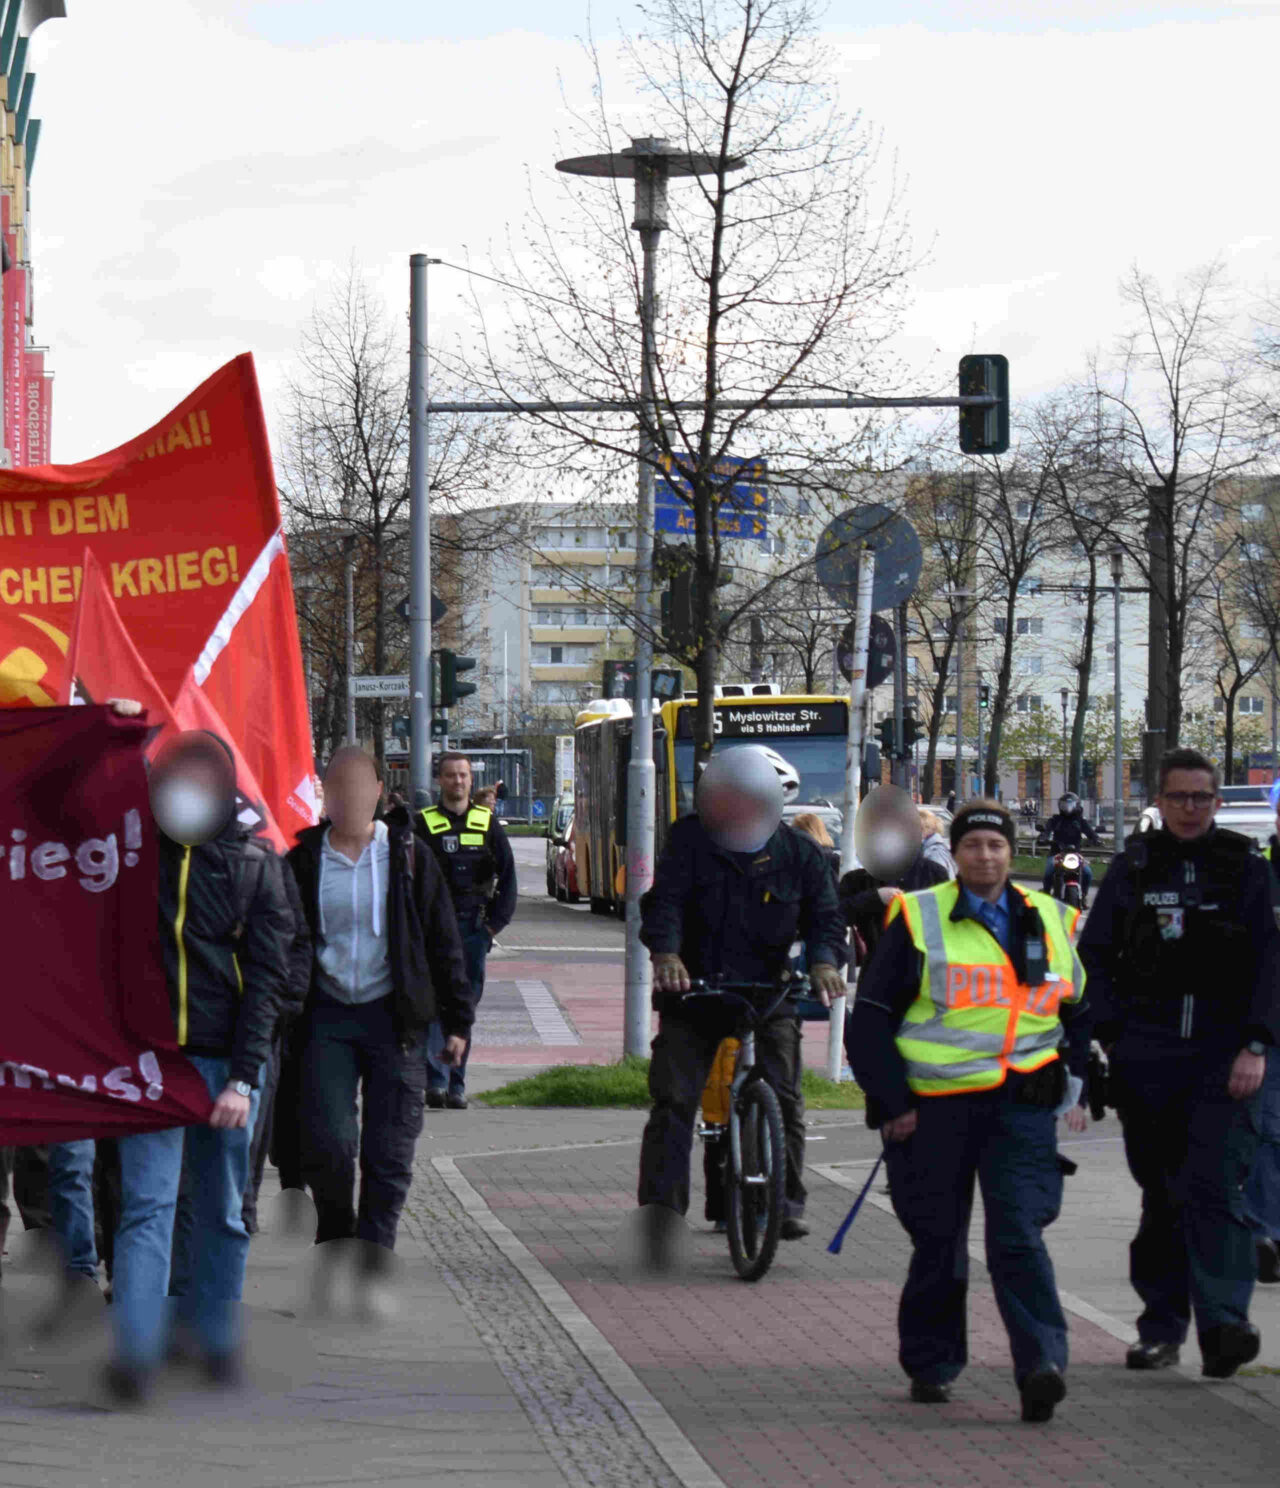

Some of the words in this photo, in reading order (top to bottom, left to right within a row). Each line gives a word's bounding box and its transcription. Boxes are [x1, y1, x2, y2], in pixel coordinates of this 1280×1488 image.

[48, 493, 130, 536] DEM
[111, 546, 240, 599] KRIEG!
[728, 710, 797, 725] Myslowitzer
[799, 708, 822, 721] Str.
[740, 725, 755, 734] via
[757, 724, 764, 733] S
[1143, 892, 1180, 906] POLIZEI
[949, 966, 1066, 1015] POLIZ
